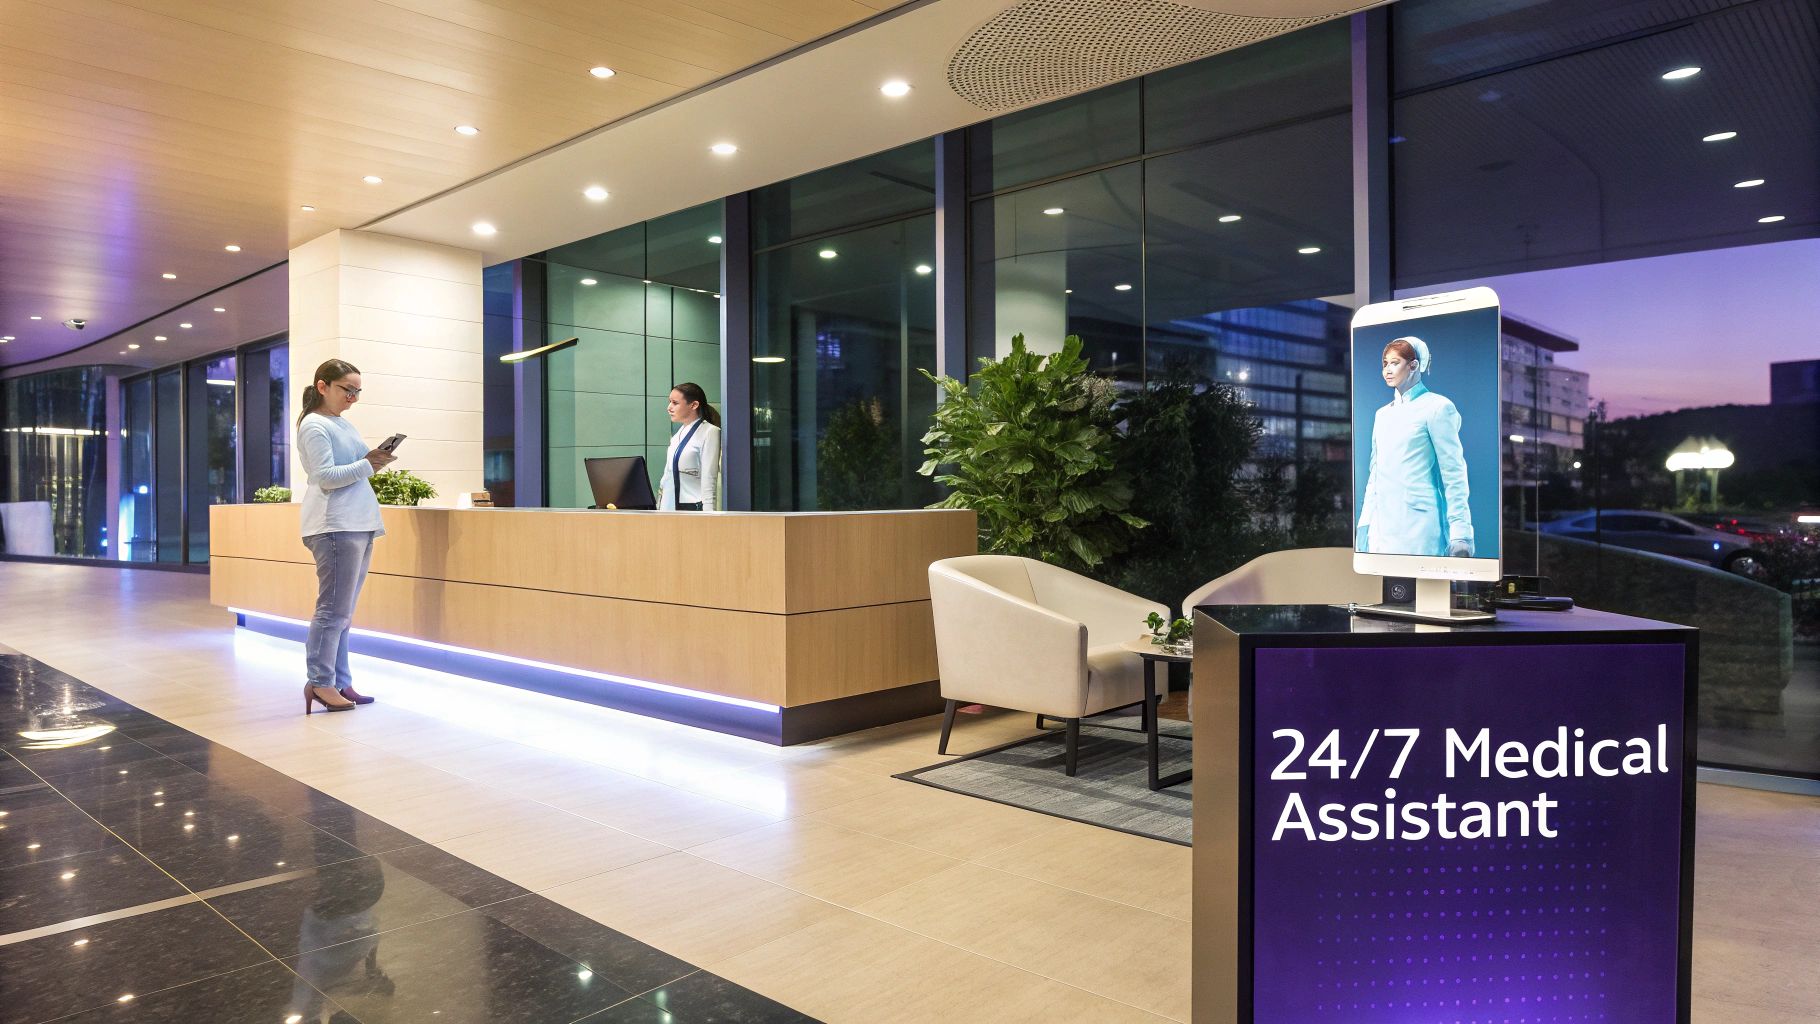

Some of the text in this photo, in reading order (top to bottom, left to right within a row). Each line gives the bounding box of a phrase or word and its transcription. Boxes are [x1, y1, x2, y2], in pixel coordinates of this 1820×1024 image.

[1270, 723, 1669, 781] 24/7 Medical
[1271, 787, 1559, 842] Assistant
